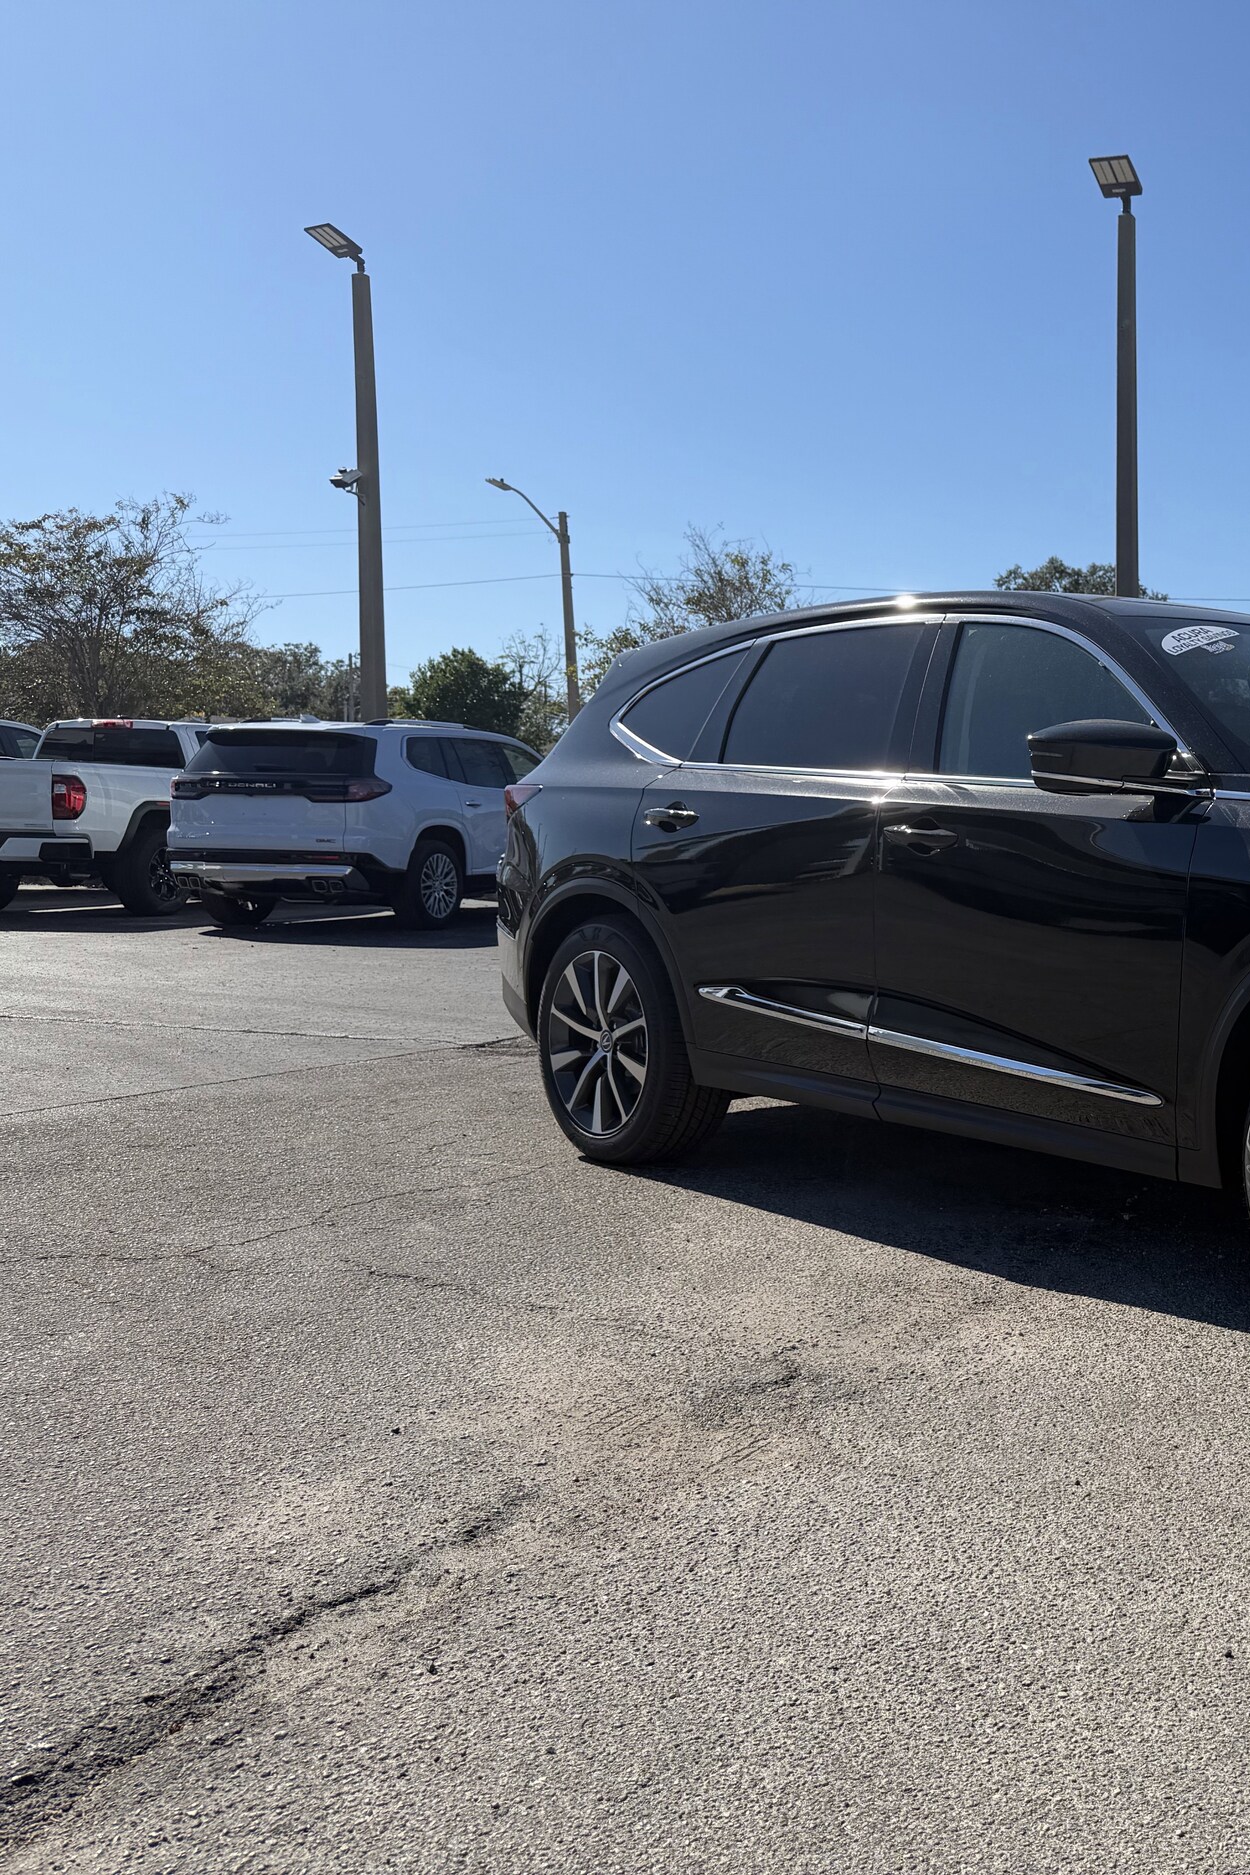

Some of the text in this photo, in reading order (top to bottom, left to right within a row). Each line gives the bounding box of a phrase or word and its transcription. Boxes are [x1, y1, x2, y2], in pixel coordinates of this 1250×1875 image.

[1167, 638, 1203, 654] LOYALTY
[1201, 629, 1236, 642] SAVINGS
[1171, 627, 1213, 643] ACURA
